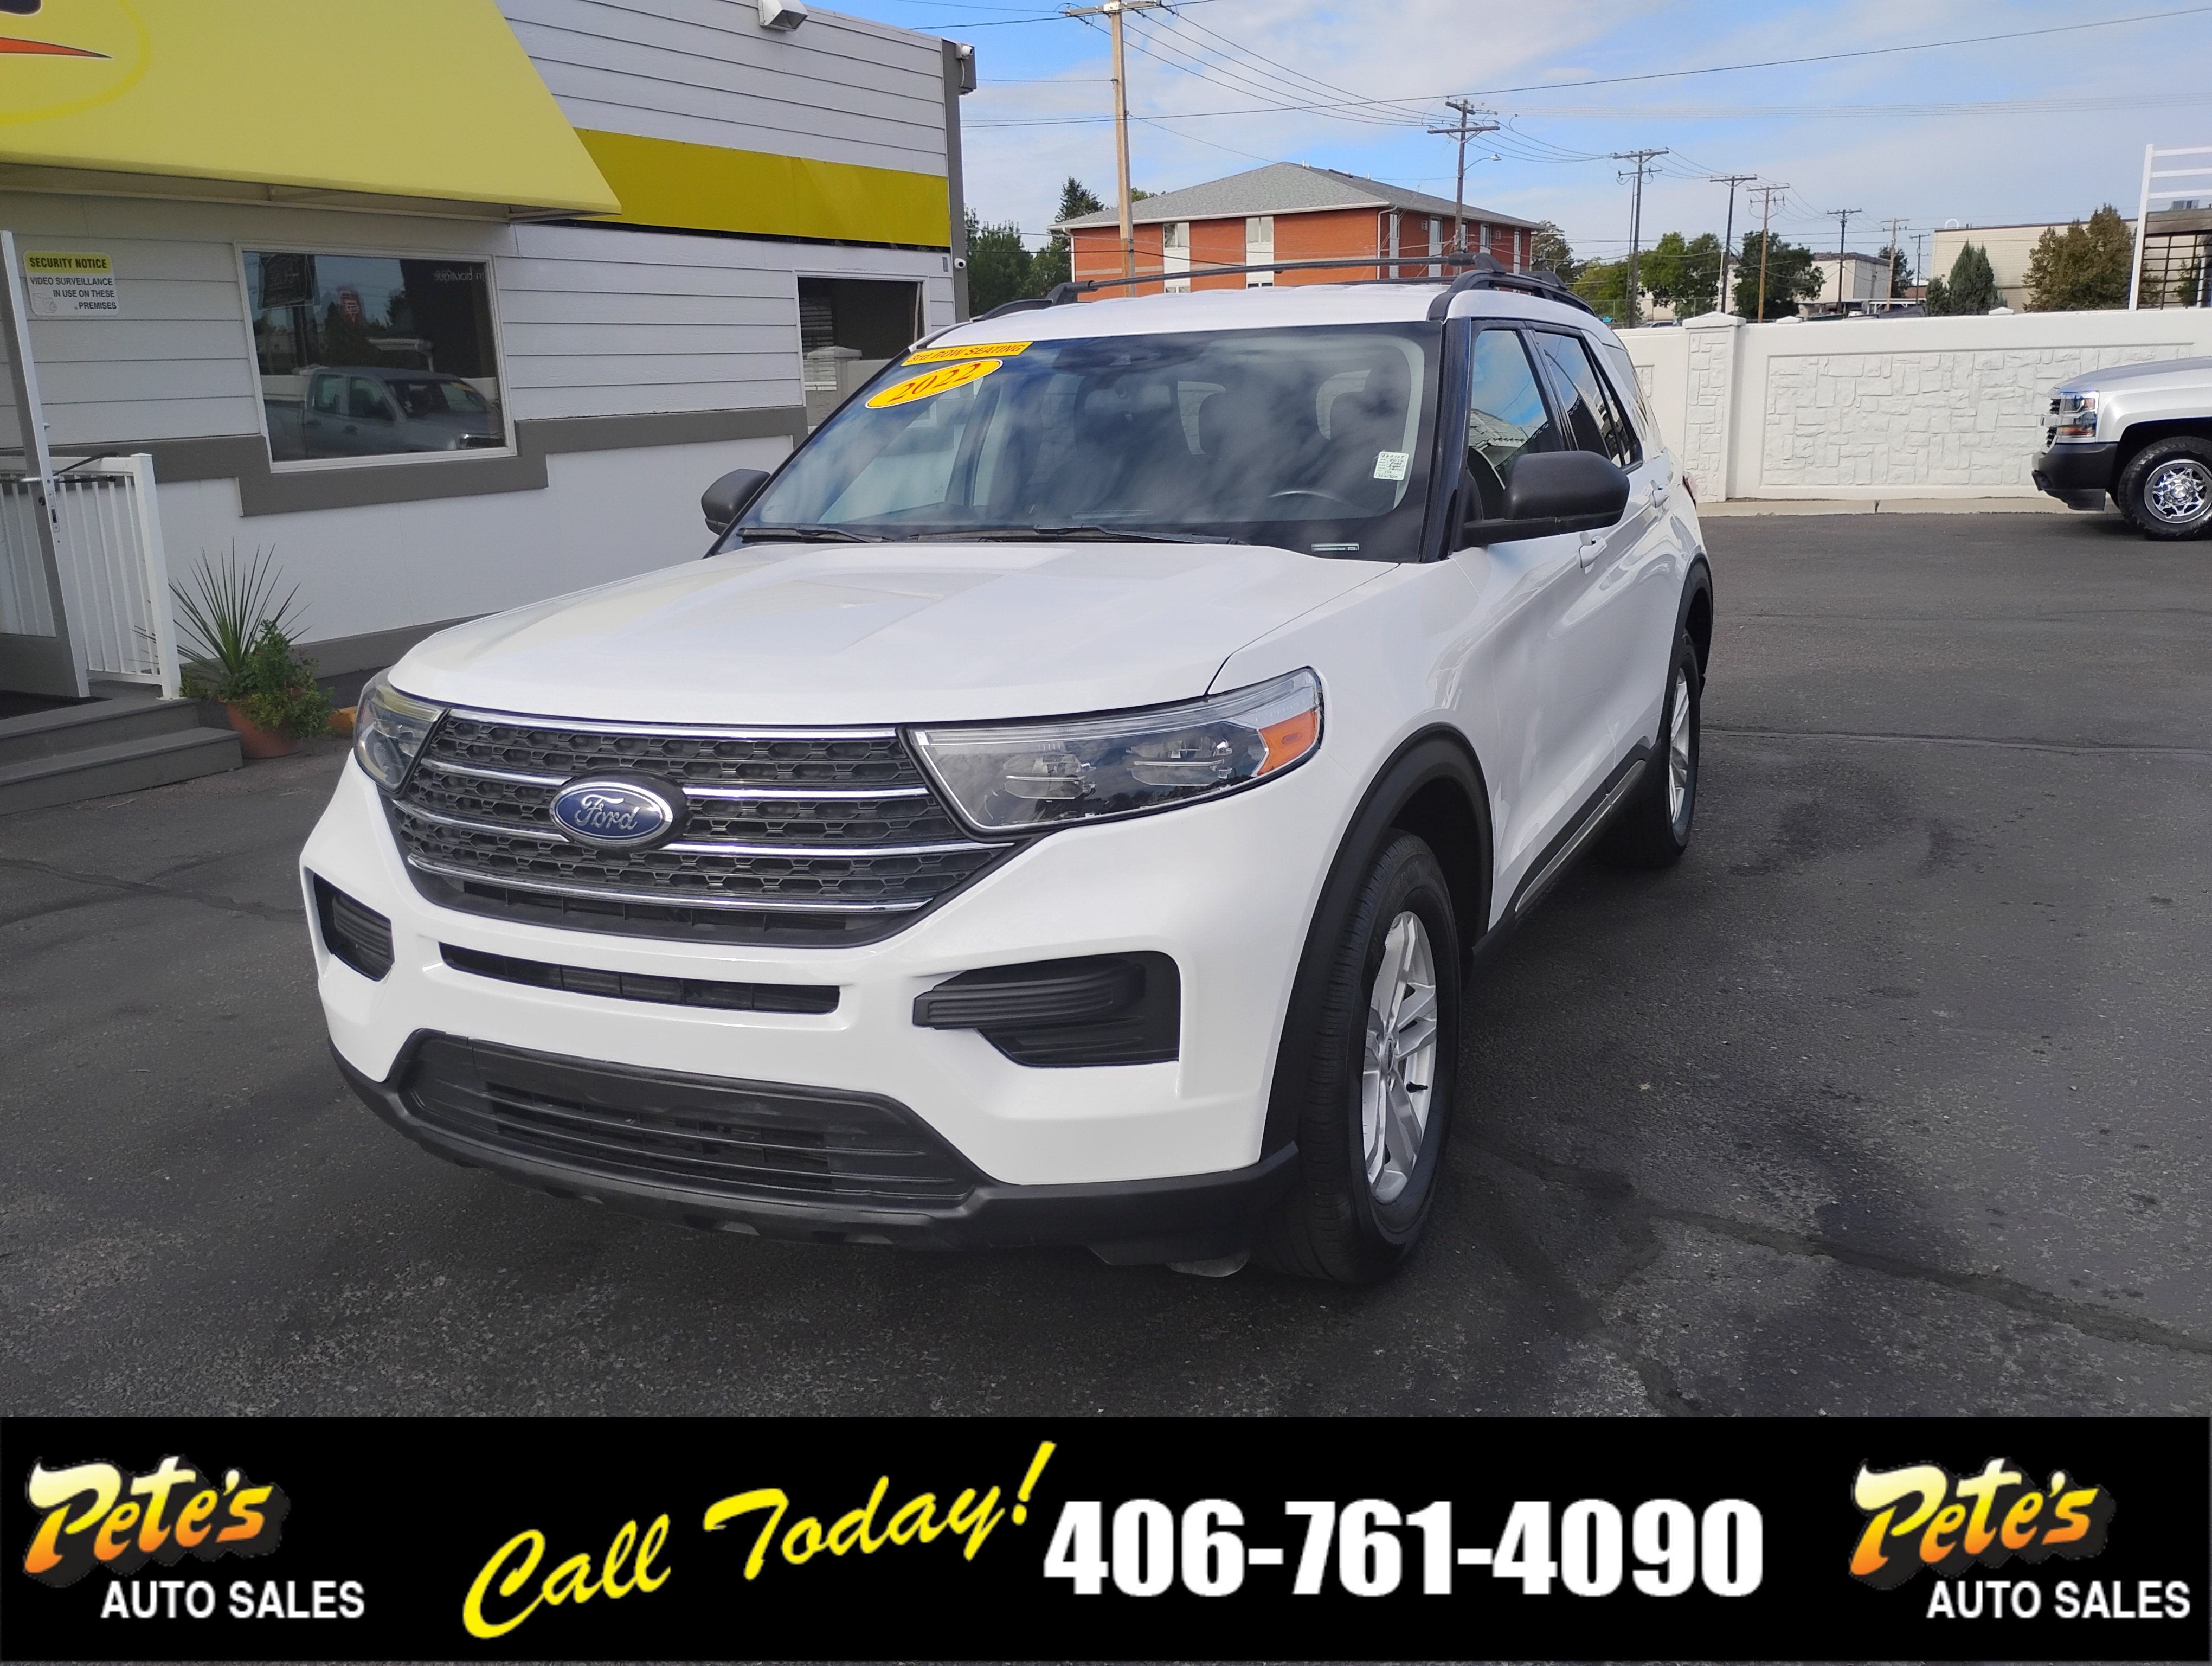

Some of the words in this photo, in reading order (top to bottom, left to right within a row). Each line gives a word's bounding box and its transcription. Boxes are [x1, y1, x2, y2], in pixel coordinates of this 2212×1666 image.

[29, 258, 72, 268] SECURITY
[75, 258, 107, 268] NOTICE
[55, 277, 113, 285] SURVEILLANCE
[933, 349, 964, 358] ROW
[966, 344, 1025, 355] SEATING
[888, 363, 981, 402] 2022
[575, 794, 640, 830] Ford
